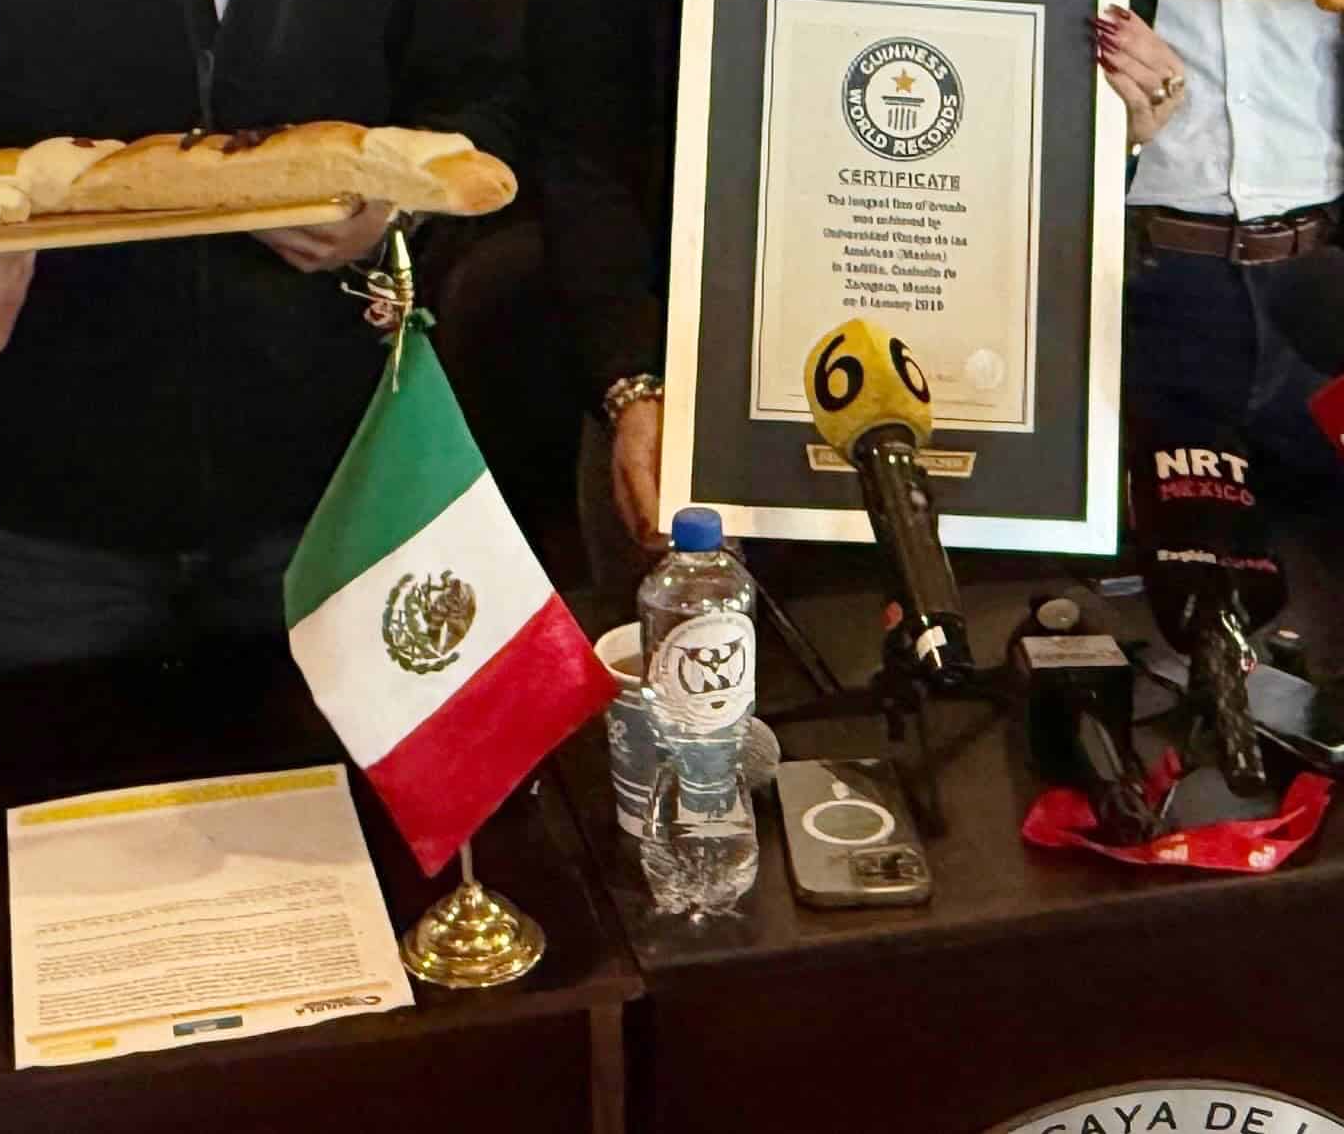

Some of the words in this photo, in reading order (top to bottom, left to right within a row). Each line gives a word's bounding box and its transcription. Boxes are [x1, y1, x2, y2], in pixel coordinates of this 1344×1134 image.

[859, 43, 949, 81] GUINNESS
[848, 88, 889, 149] WORLD
[892, 94, 958, 156] RECORDS
[838, 168, 961, 191] CERTIFICATE
[814, 334, 864, 412] 6
[1154, 448, 1249, 484] NRT
[1205, 1102, 1273, 1134] DE
